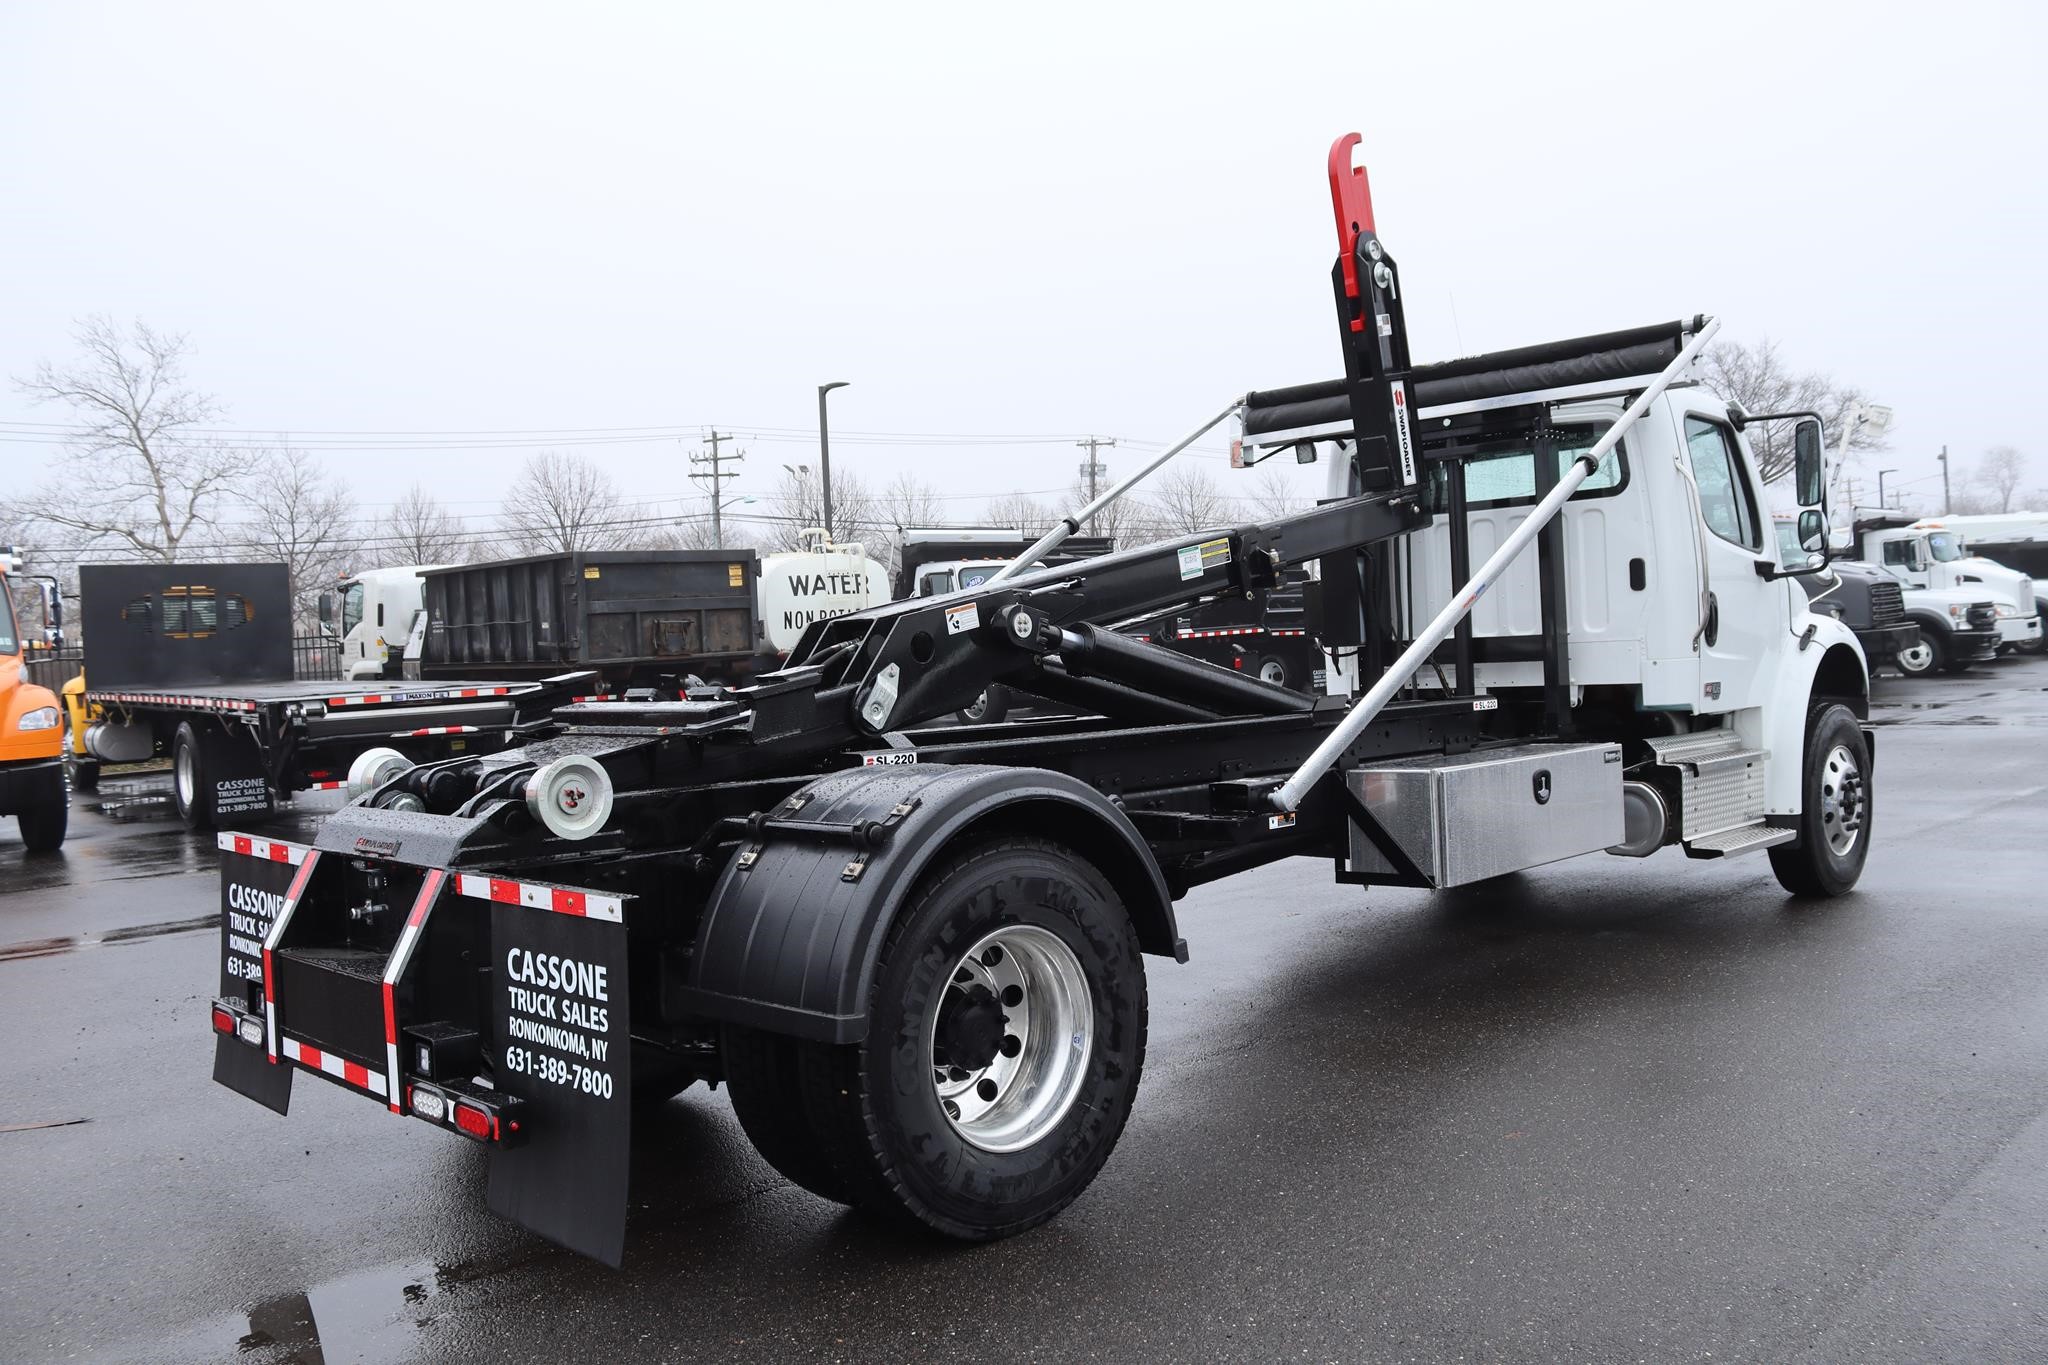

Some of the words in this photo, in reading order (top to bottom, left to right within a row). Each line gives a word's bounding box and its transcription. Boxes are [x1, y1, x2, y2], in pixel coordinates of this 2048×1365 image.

[1398, 408, 1412, 477] SWAPLOADER
[788, 574, 869, 596] WATER
[784, 610, 814, 630] NON
[876, 754, 914, 765] SL-220
[217, 778, 264, 790] CASSONE
[217, 802, 267, 813] 631-389-7800
[229, 912, 256, 936] TRUCK
[229, 933, 262, 958] RONKONK
[507, 948, 608, 1001] CASSONE
[508, 986, 557, 1020] TRUCK
[562, 999, 609, 1033] SALES
[509, 1015, 590, 1060] RONKONKOMA,
[591, 1038, 608, 1062] NY
[506, 1046, 612, 1099] 631-389-7800
